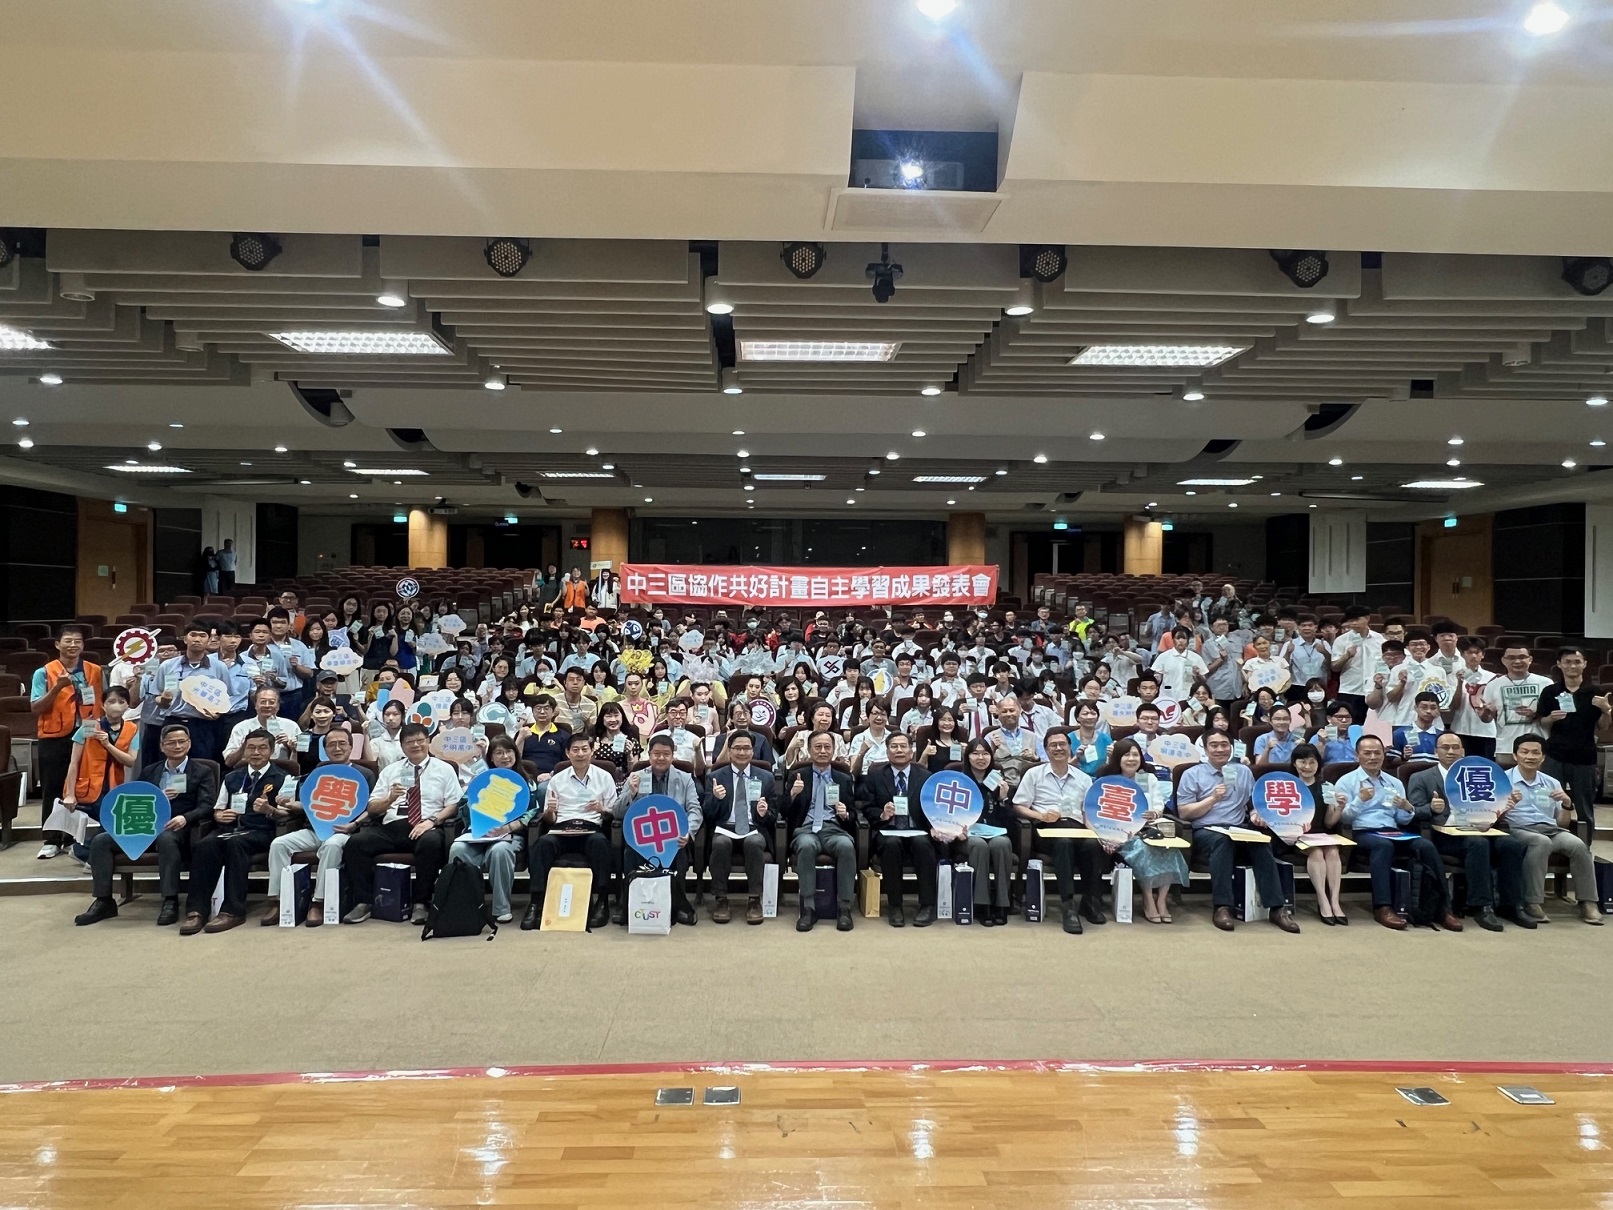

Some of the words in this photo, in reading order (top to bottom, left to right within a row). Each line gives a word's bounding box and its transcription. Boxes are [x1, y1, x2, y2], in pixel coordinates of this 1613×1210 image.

[626, 572, 991, 600] 中三區協作共好計畫自主學習成果發表會
[200, 680, 222, 697] 中三區
[444, 735, 467, 743] 中三區
[1164, 740, 1187, 750] 中三區
[311, 775, 359, 821] 學
[934, 780, 972, 814] 中
[1265, 780, 1301, 816] 學
[1454, 765, 1495, 802] 優
[112, 794, 157, 836] 優
[1097, 784, 1136, 822] 臺
[632, 806, 679, 854] 中
